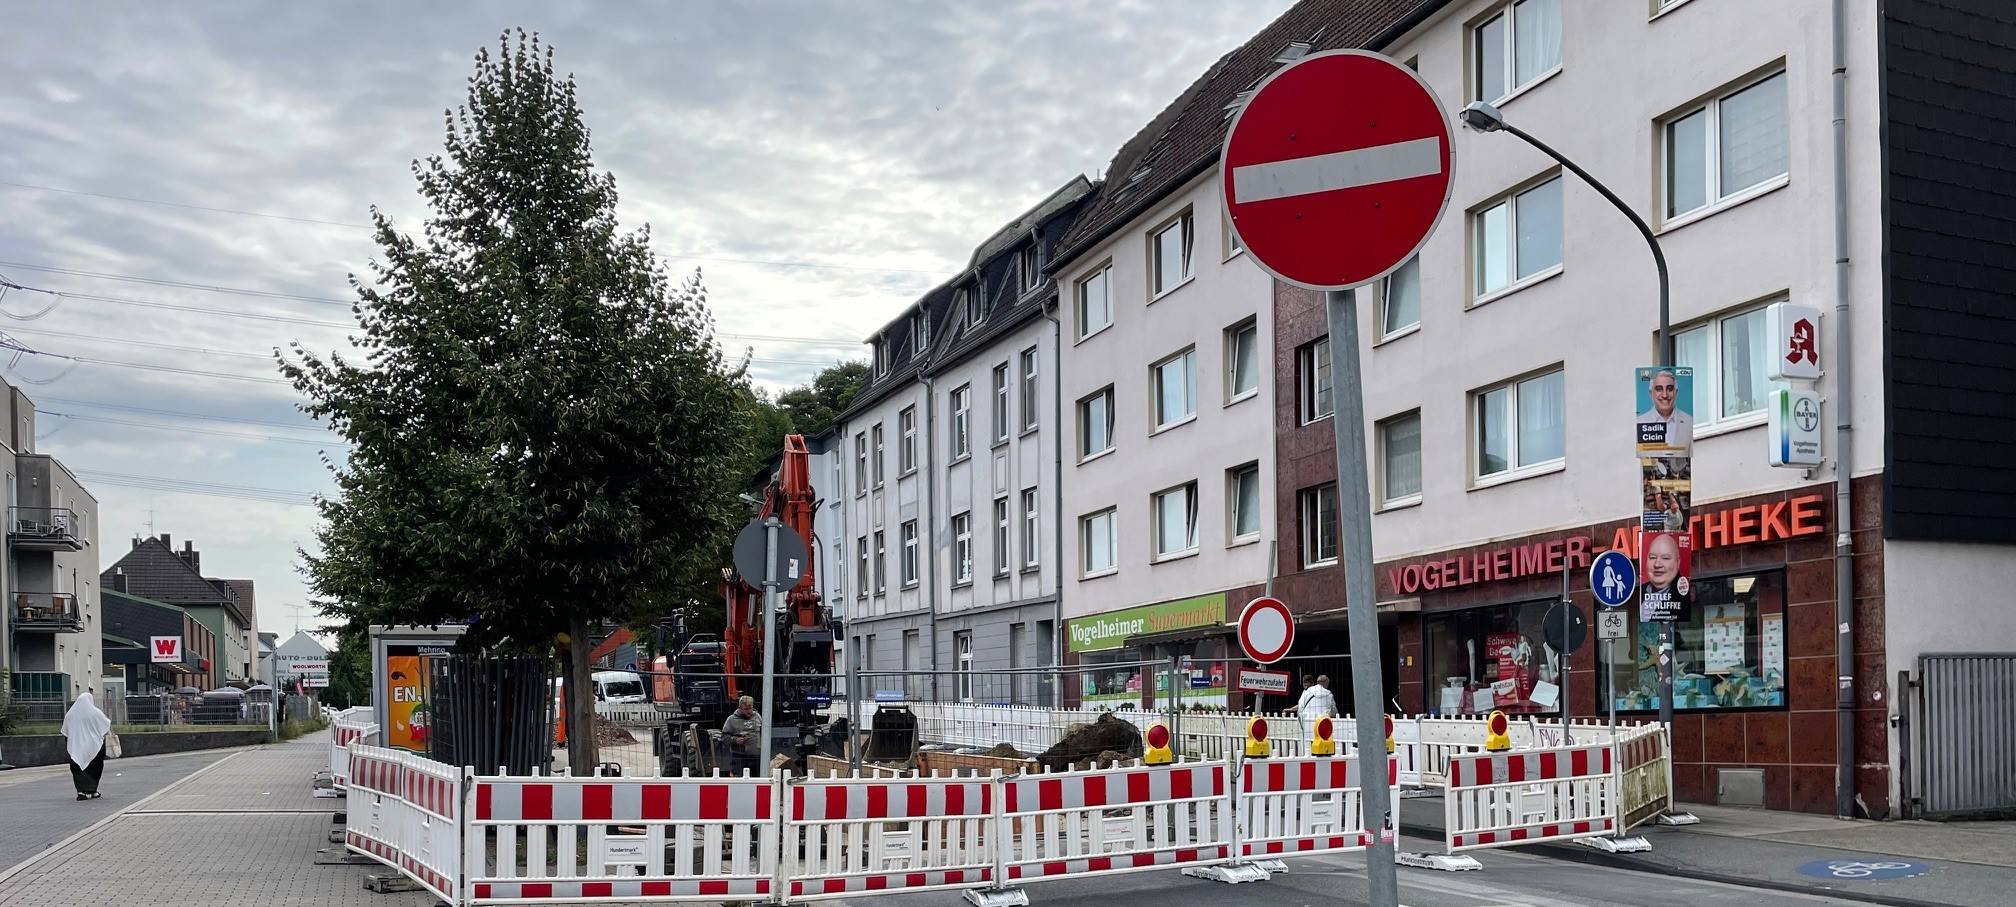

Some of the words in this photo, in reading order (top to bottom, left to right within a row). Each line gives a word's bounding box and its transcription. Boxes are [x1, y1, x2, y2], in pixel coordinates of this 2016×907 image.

[1642, 424, 1664, 432] Sadik
[1644, 593, 1672, 601] DETLEF
[1644, 601, 1681, 610] SCHLIFFKE
[1071, 617, 1144, 645] Vogelheimer
[1148, 600, 1221, 632] Supermarkt
[155, 639, 177, 655] W
